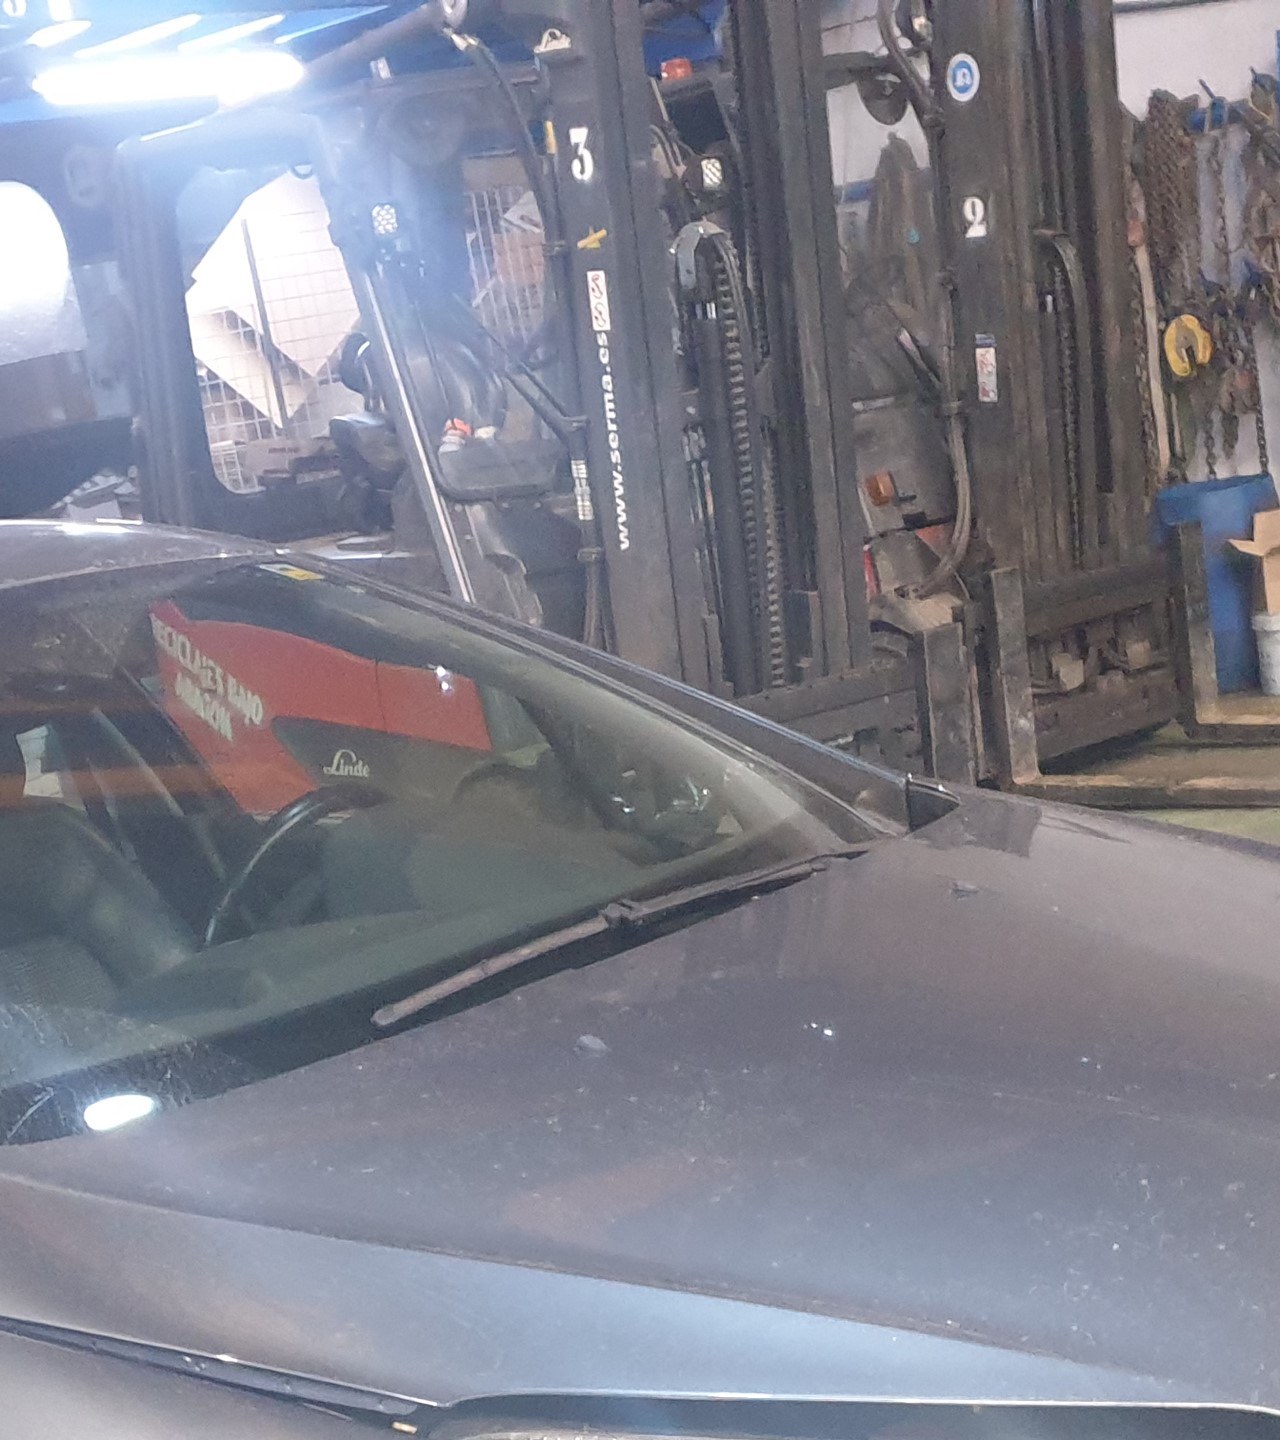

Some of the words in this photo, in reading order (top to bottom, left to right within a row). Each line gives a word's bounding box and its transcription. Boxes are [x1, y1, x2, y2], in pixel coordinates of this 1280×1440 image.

[569, 127, 594, 182] 3
[963, 196, 987, 238] 2
[597, 332, 630, 551] www.serma.es
[323, 749, 370, 778] Linde
